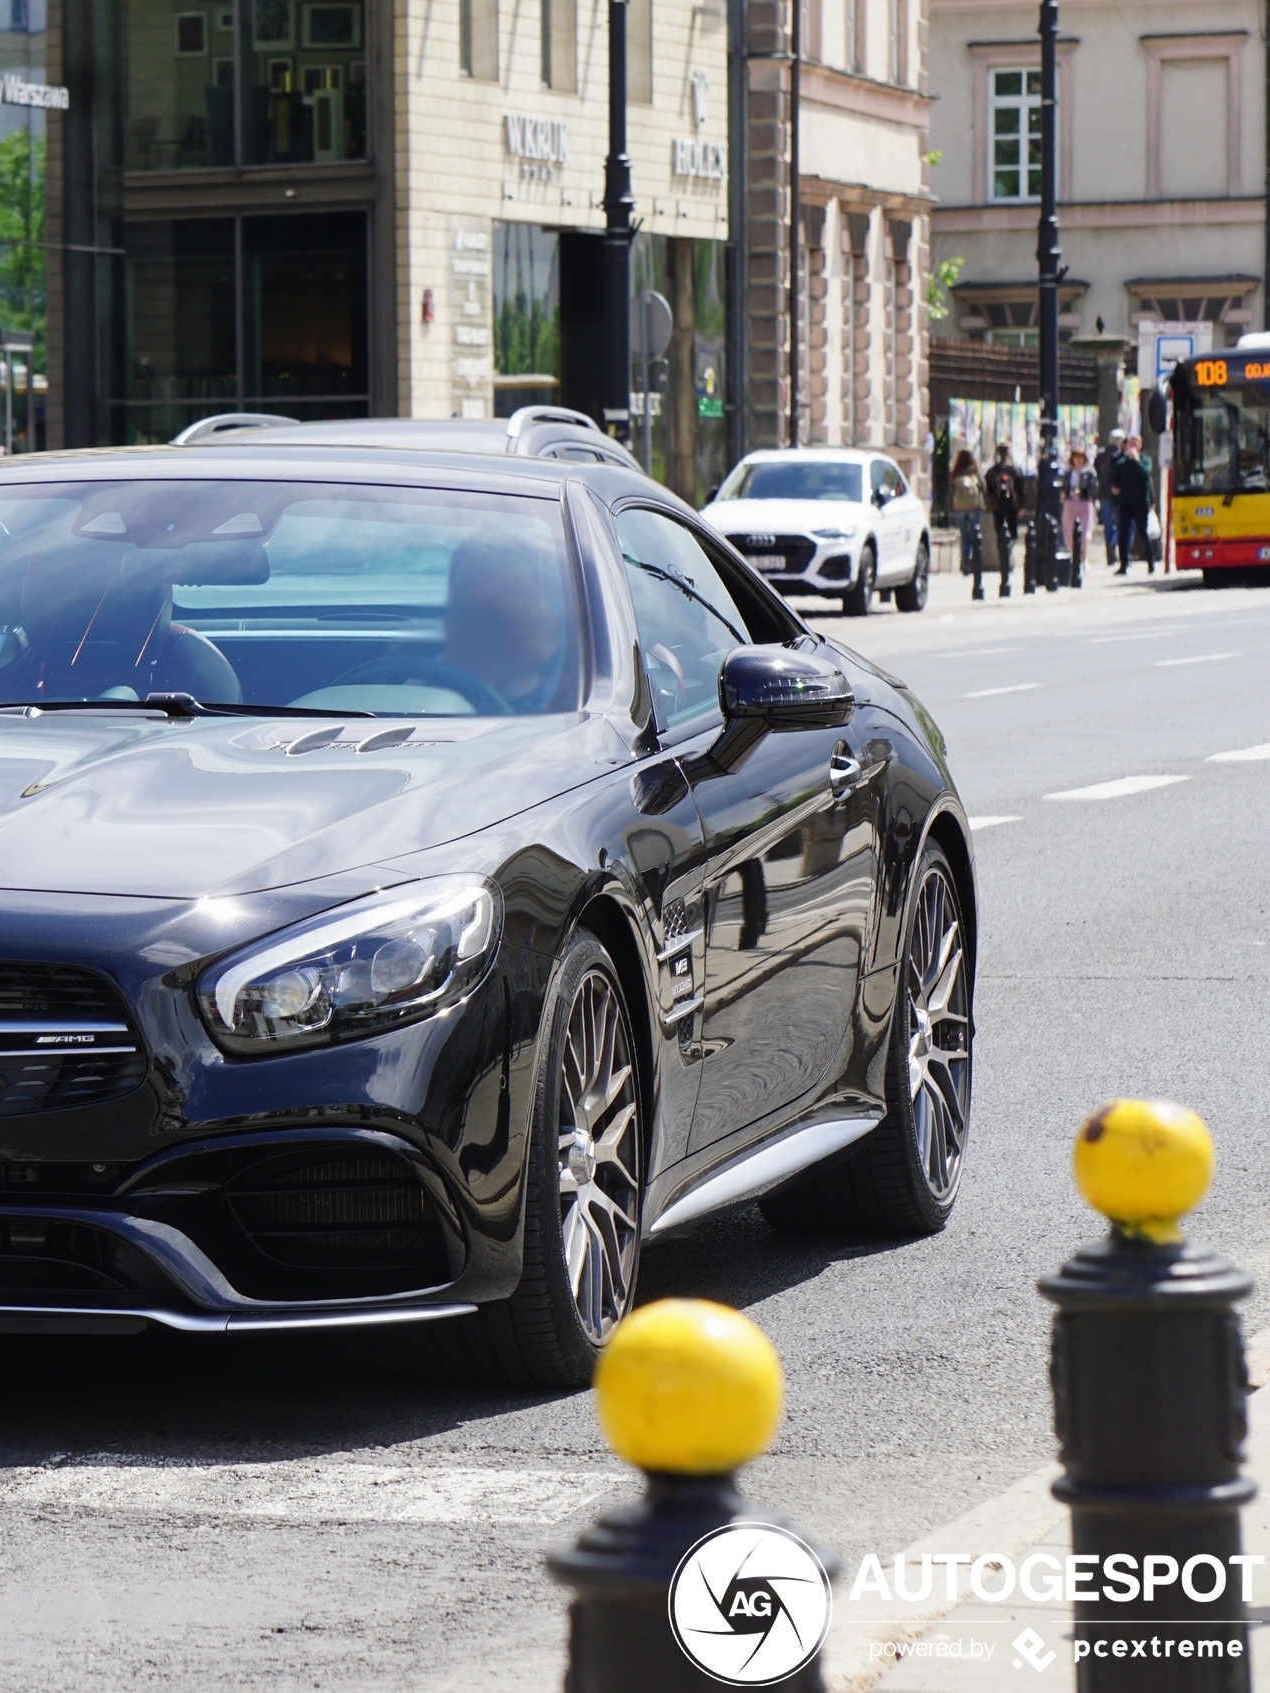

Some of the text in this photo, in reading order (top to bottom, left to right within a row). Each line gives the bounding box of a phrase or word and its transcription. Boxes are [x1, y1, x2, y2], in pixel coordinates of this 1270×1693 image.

[4, 72, 69, 109] Warszawa
[672, 139, 725, 179] ROLEX
[1194, 360, 1228, 386] 108
[675, 957, 688, 976] V8
